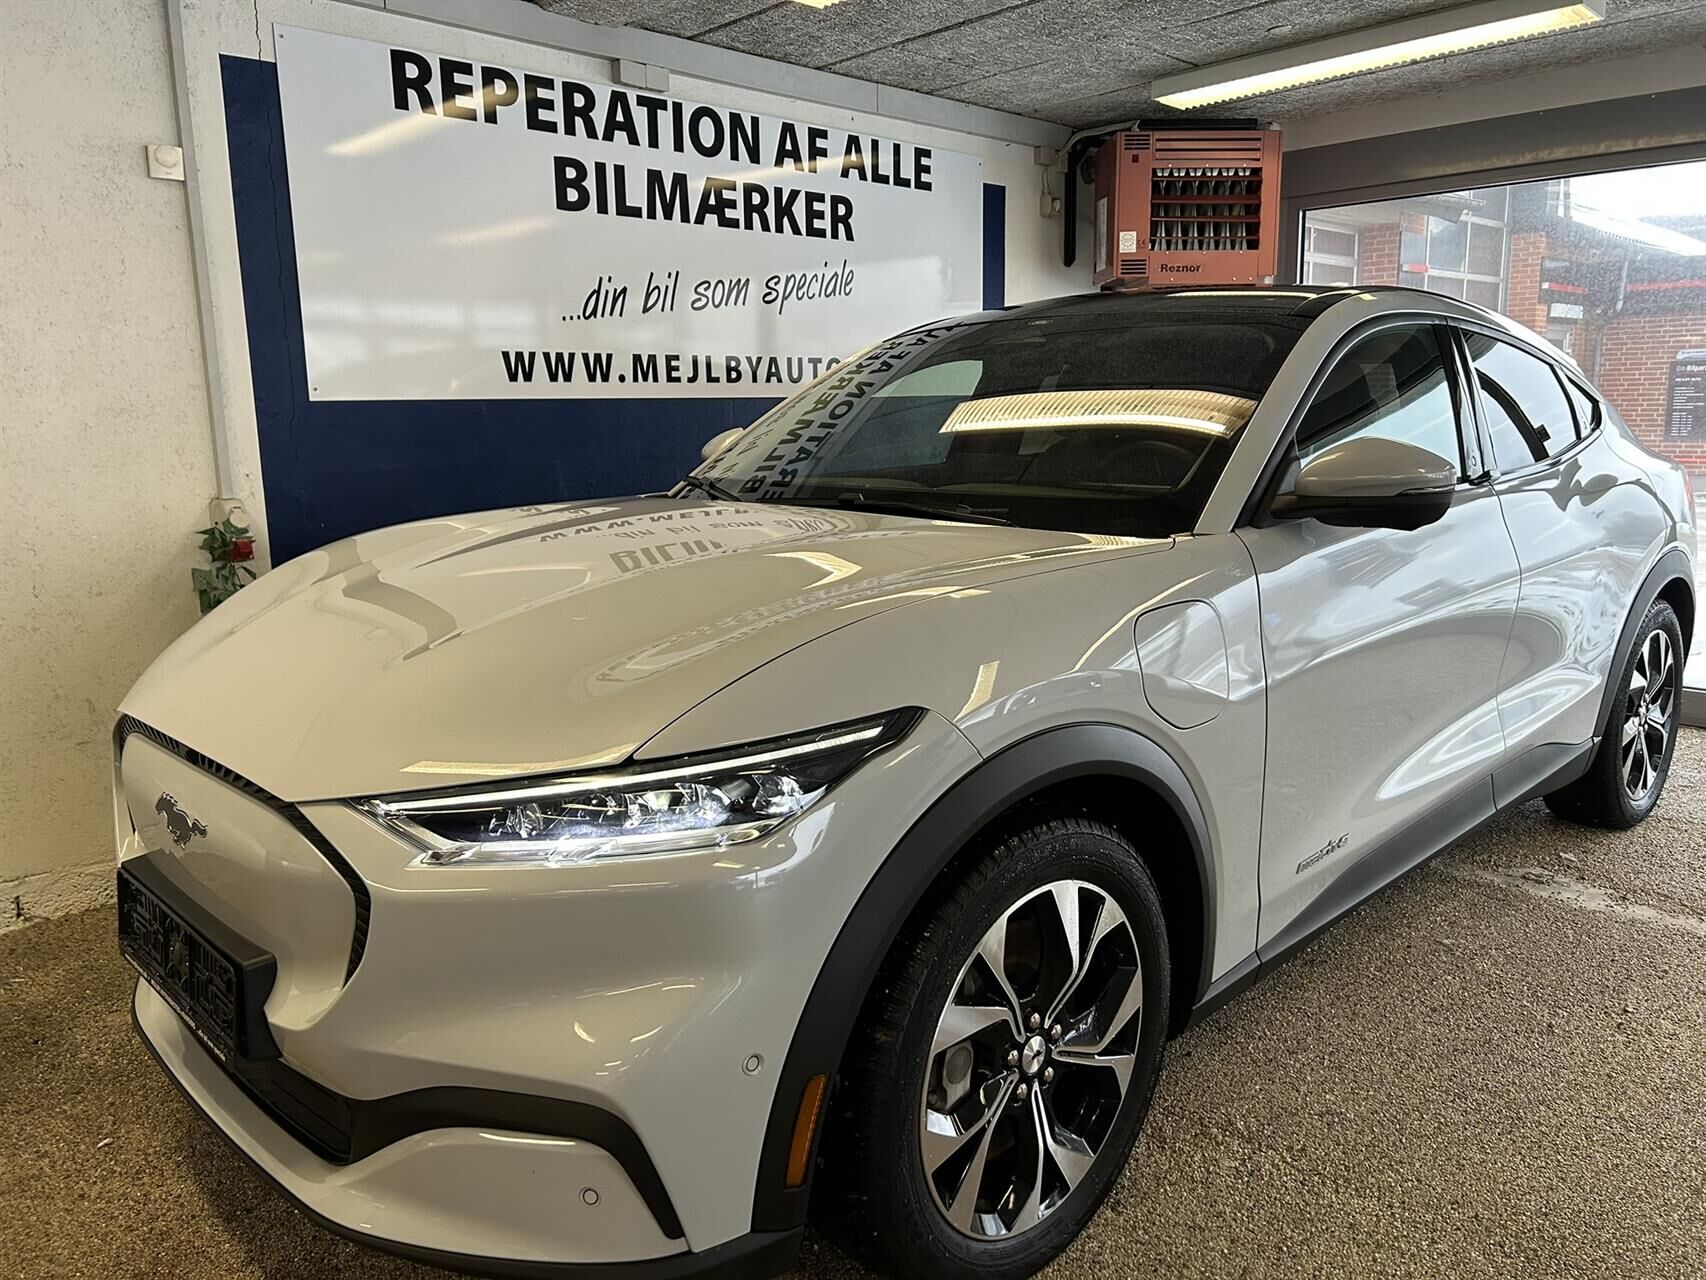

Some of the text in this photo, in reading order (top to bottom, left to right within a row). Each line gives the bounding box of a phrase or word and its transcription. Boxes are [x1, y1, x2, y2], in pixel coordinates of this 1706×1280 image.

[388, 48, 933, 192] REPERATION AF ALLE
[553, 155, 855, 242] BILMÆRKER
[562, 259, 855, 321] ...din bil som speciale
[1160, 263, 1201, 272] Reznor
